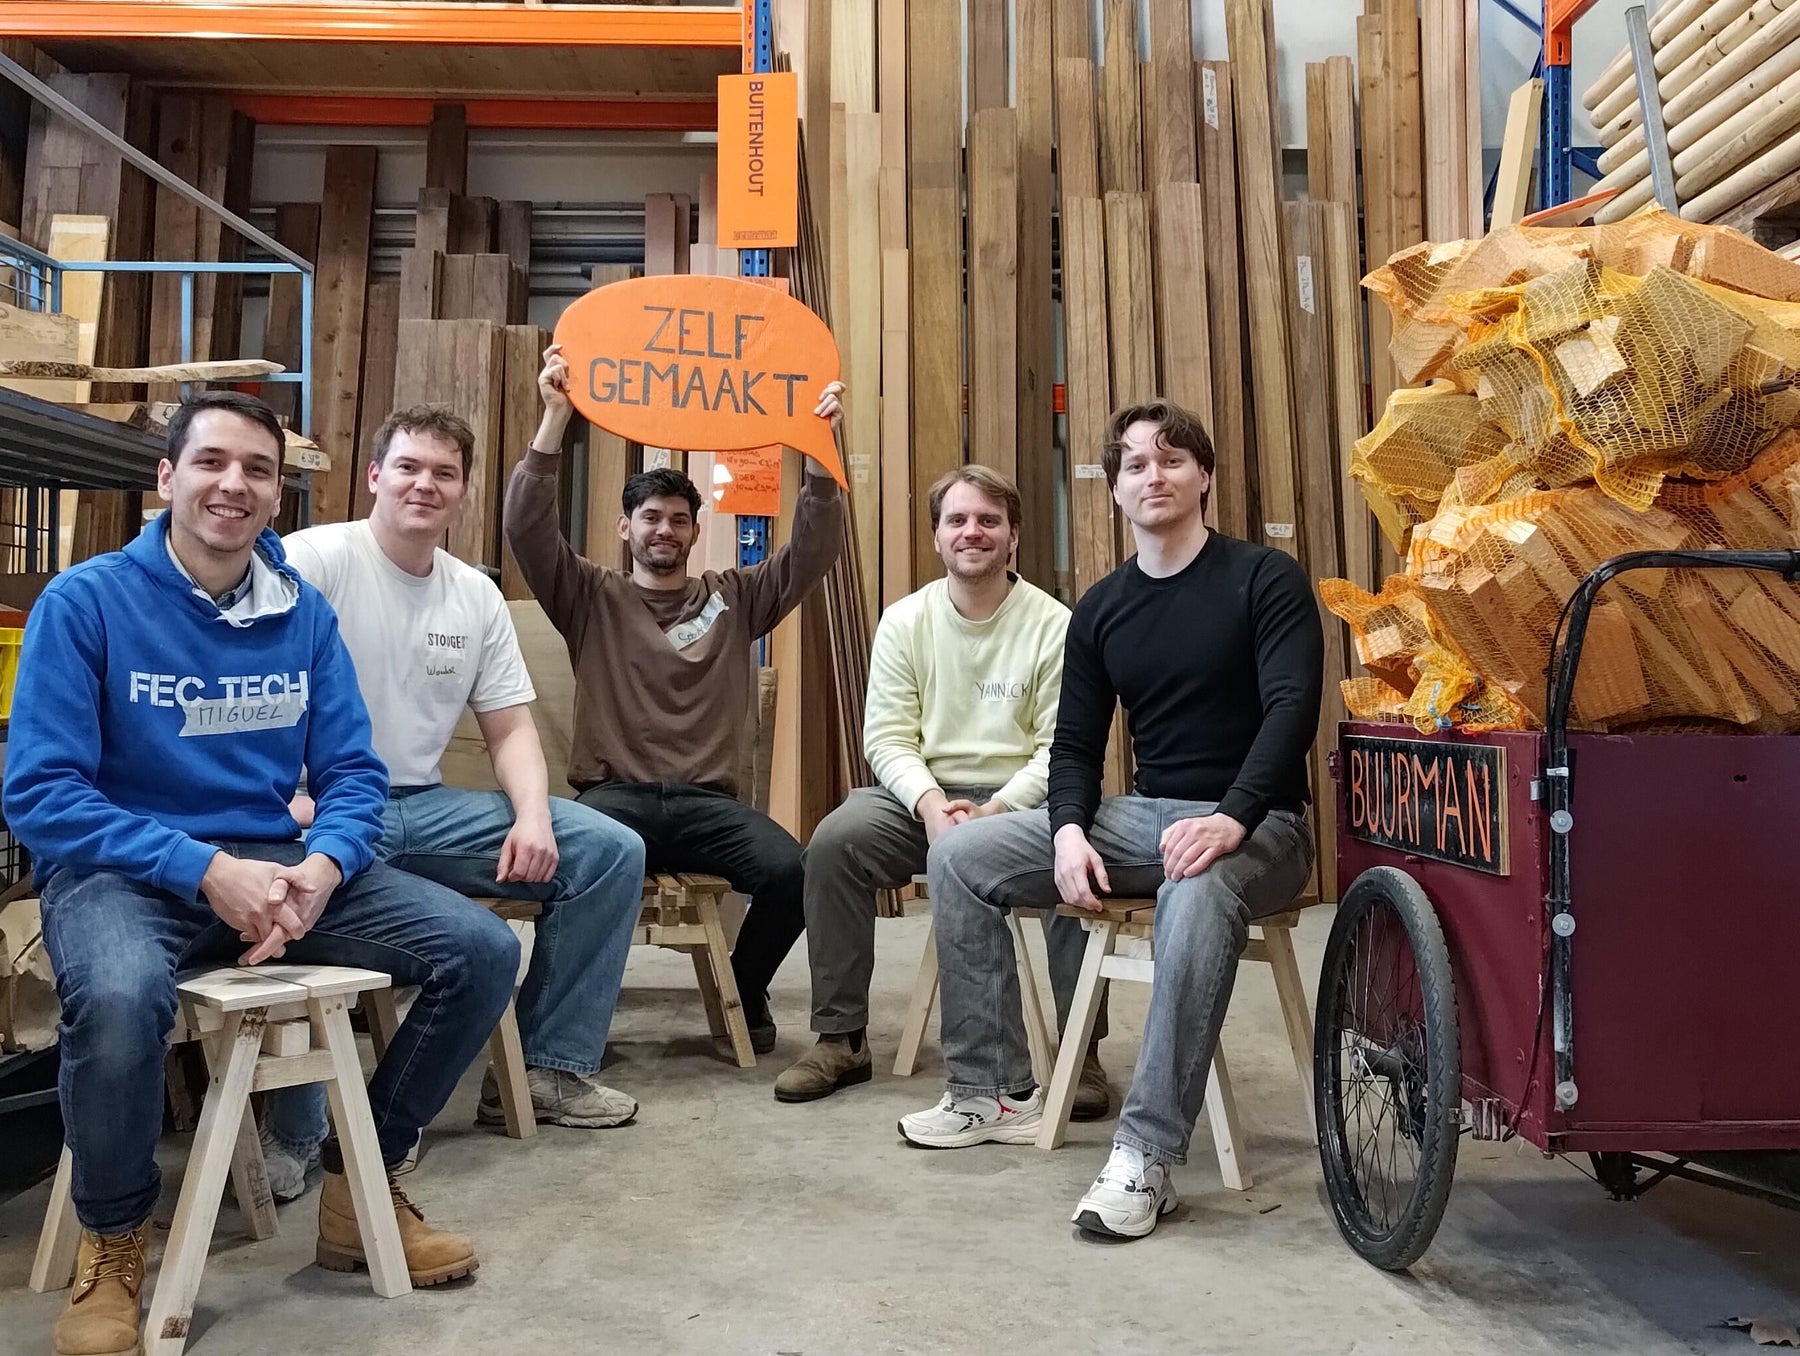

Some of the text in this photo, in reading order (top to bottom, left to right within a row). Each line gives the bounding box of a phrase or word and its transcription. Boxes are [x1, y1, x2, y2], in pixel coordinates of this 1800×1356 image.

[748, 81, 764, 196] BUITENHOUT
[644, 305, 765, 360] ZELF
[589, 357, 809, 417] GEMAAKT
[129, 670, 309, 708] FEC TECH
[199, 704, 283, 726] MIGUEL
[975, 680, 1030, 700] YANNICK
[1351, 749, 1491, 863] BUURMAN
